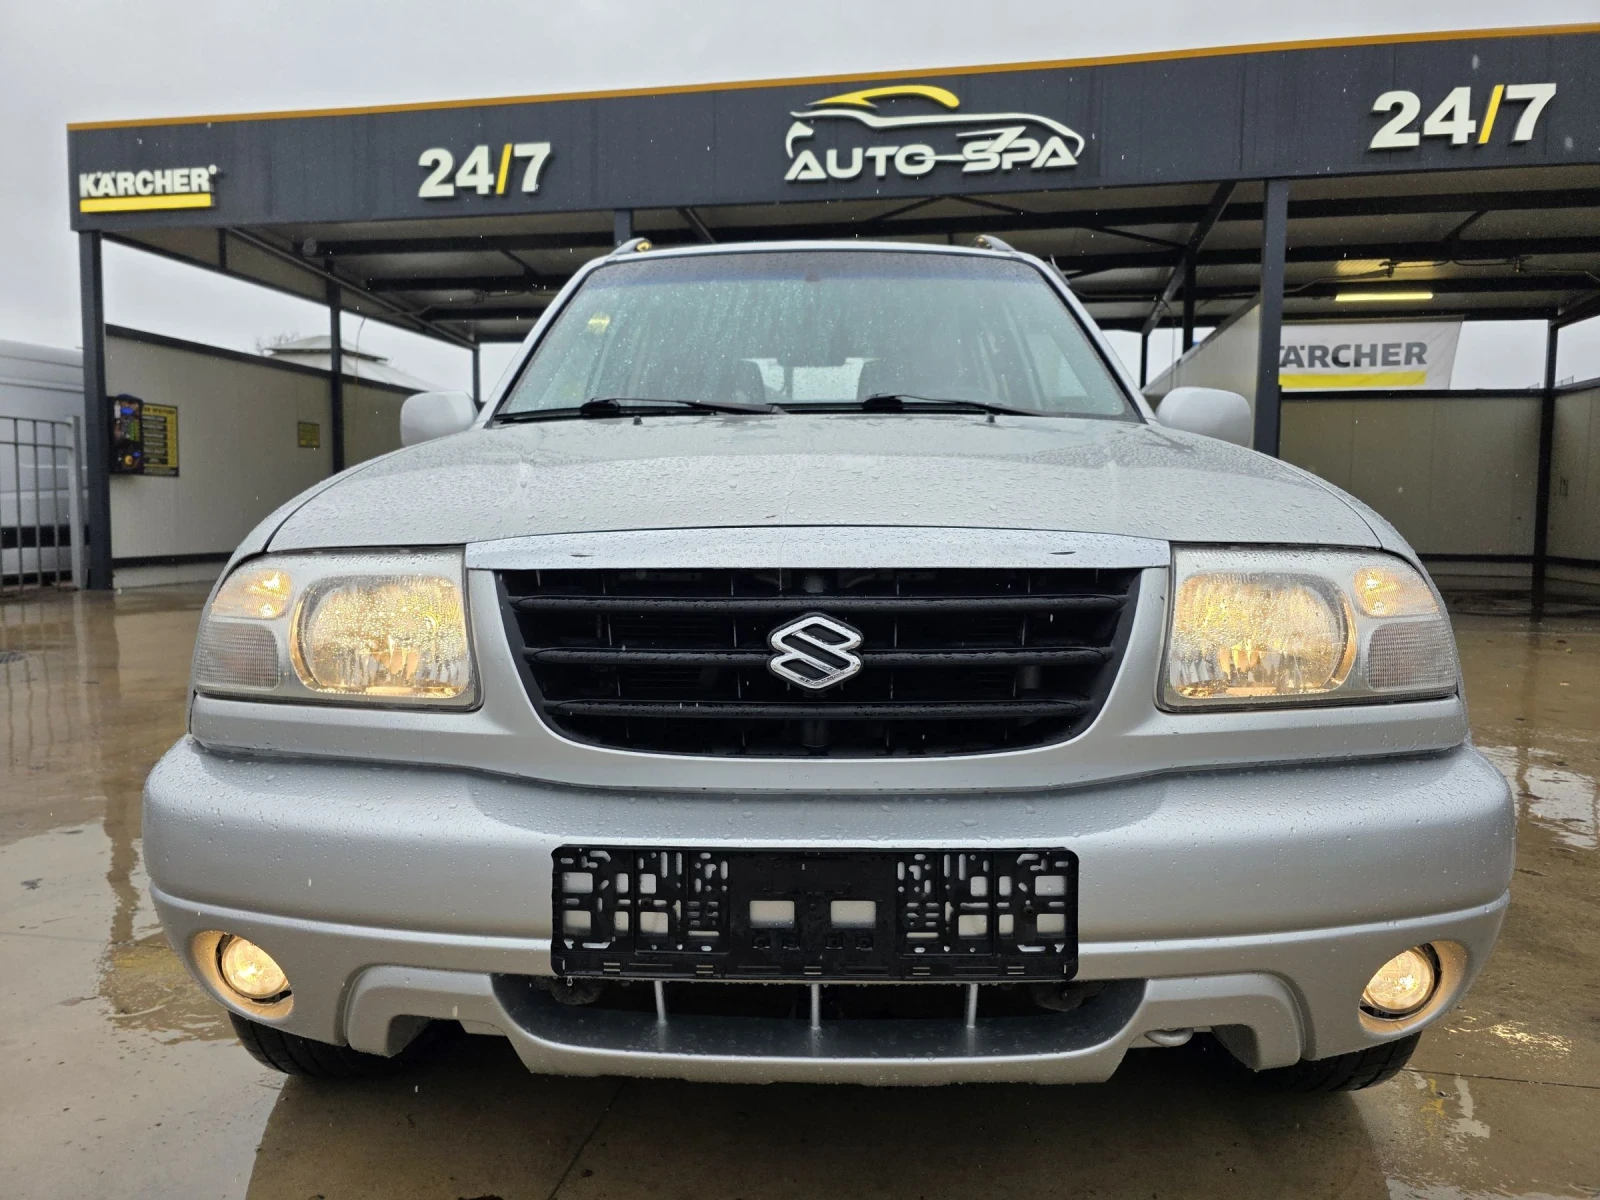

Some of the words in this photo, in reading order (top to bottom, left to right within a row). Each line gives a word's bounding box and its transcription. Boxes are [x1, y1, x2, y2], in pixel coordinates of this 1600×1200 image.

[1369, 83, 1557, 149] 24/7
[417, 142, 551, 198] 24/7
[784, 144, 936, 181] AUTO
[957, 126, 1079, 173] SPA
[1279, 341, 1428, 369] ÄRCHER
